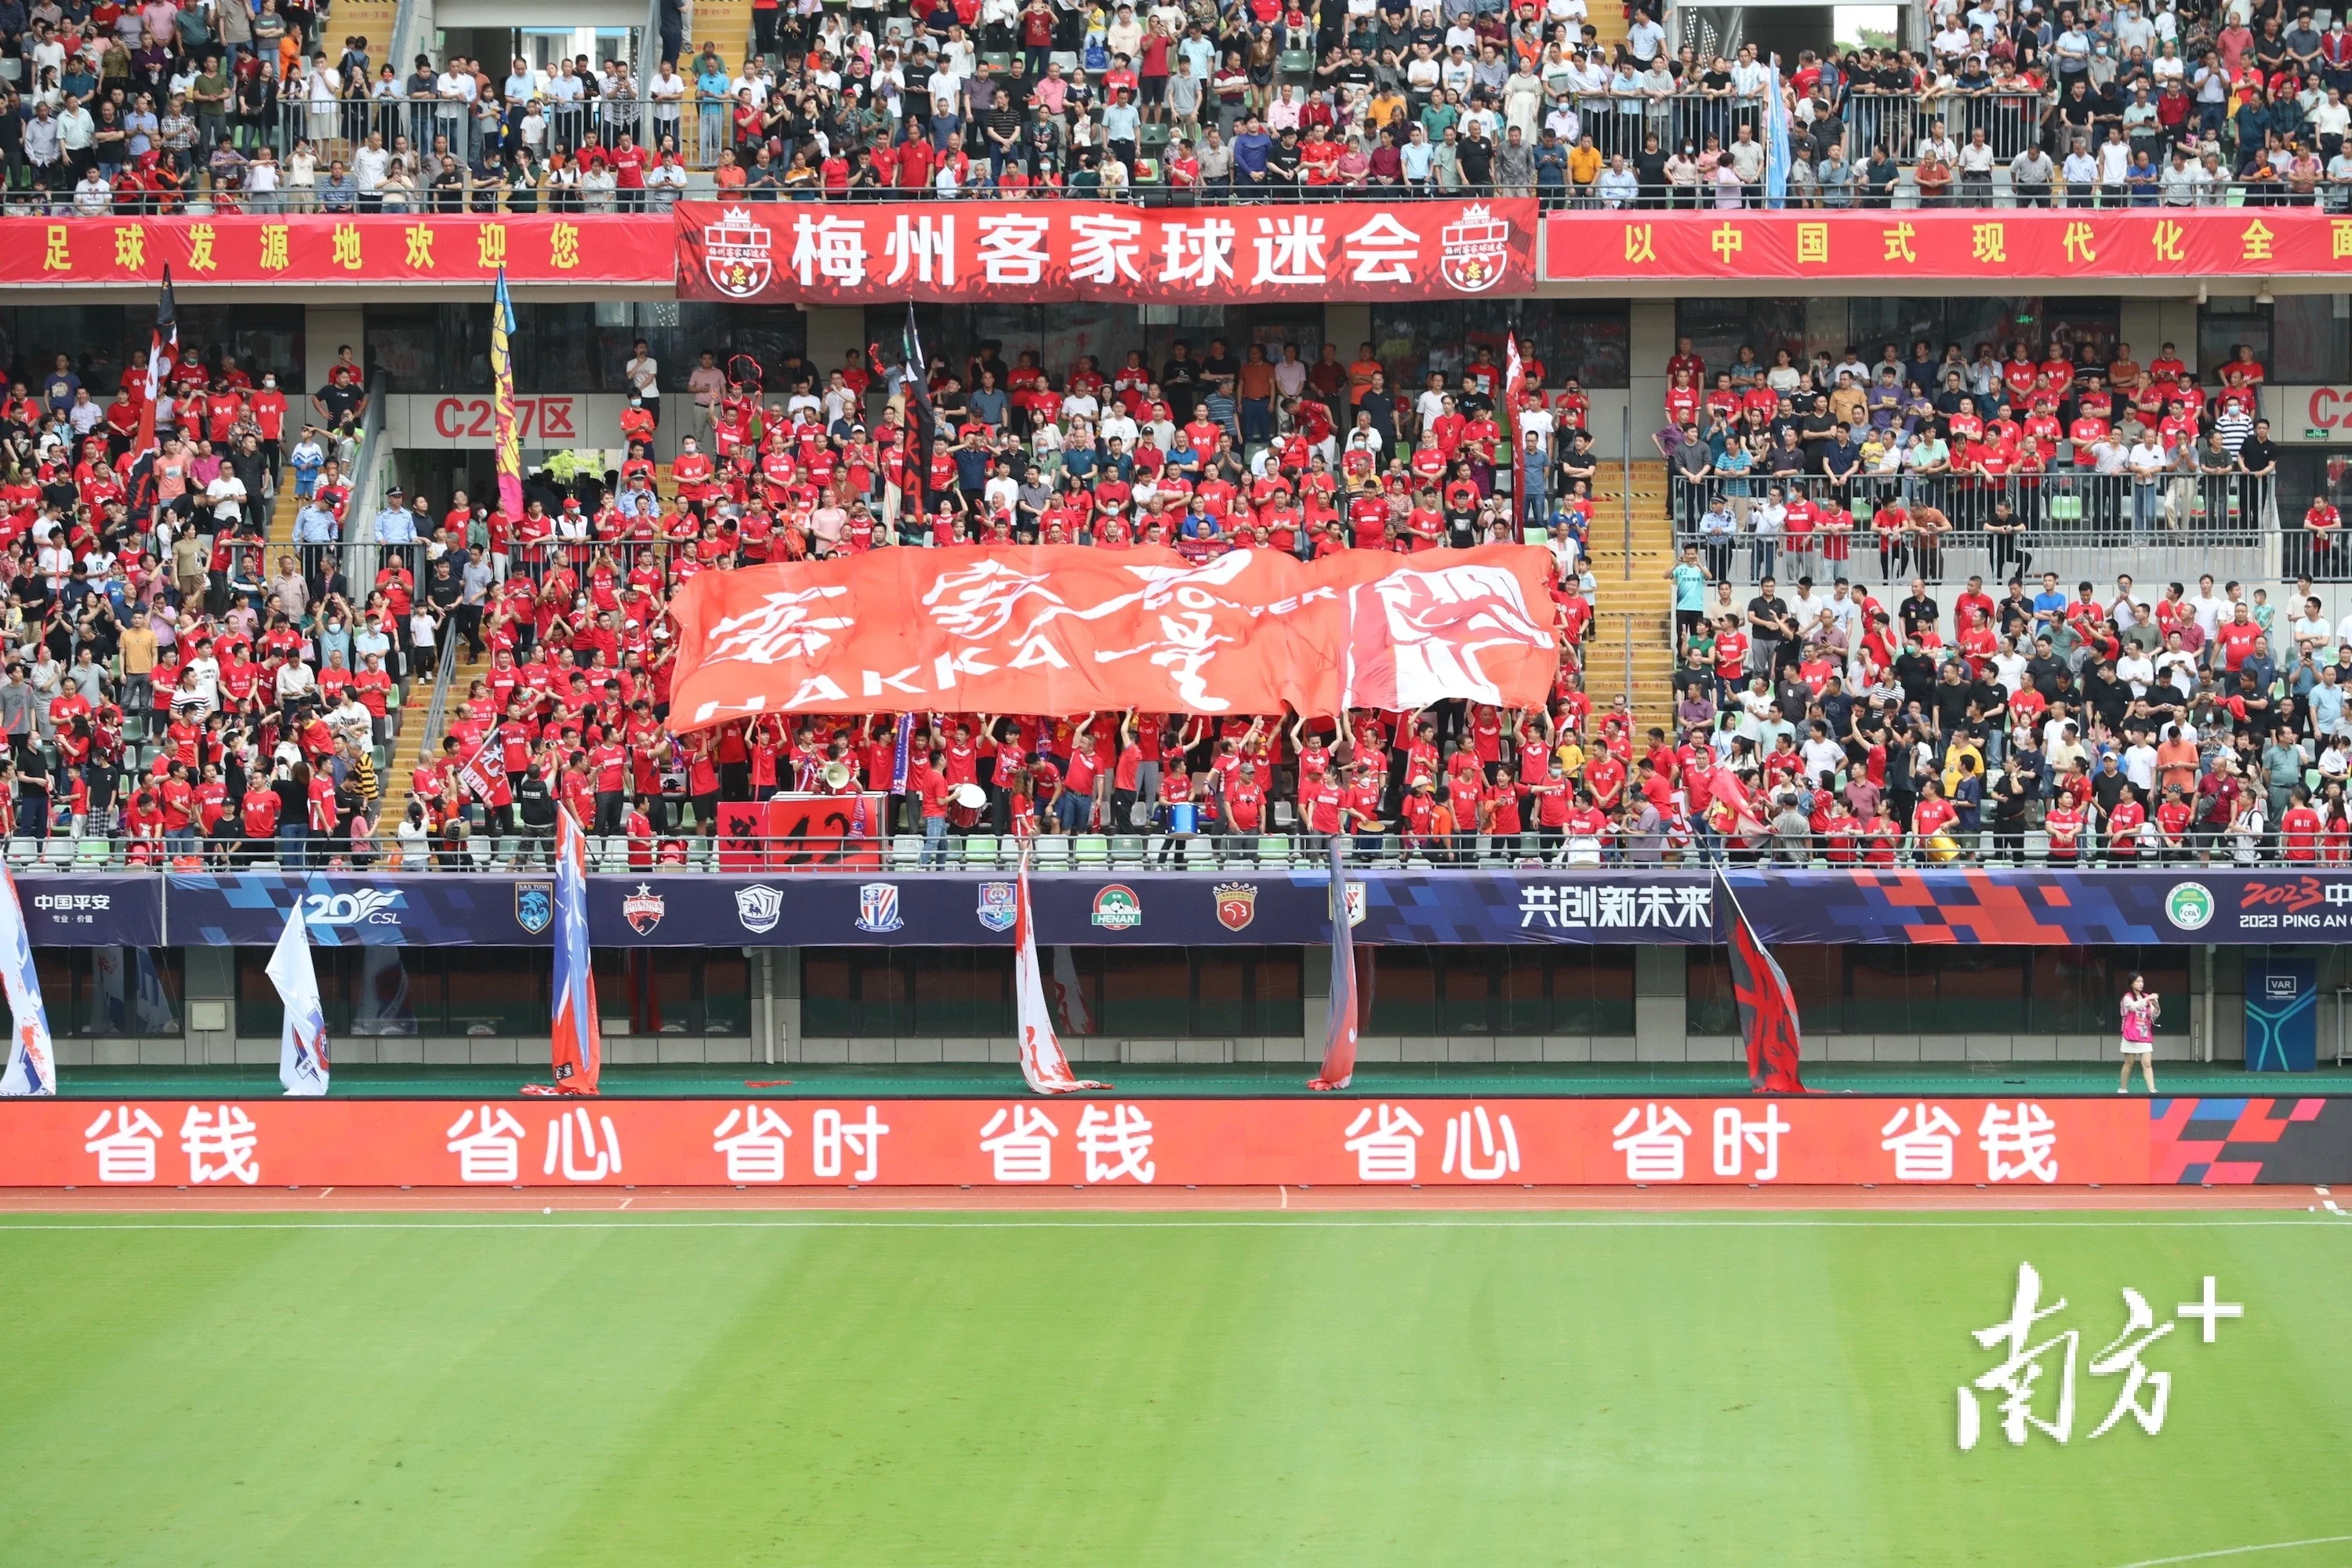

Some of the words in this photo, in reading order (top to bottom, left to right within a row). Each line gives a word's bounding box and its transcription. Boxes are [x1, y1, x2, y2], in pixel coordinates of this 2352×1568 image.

[44, 223, 579, 270] 足球发源地欢迎您
[792, 212, 1421, 287] 梅州客家球迷会
[435, 396, 576, 439] C27区
[96, 561, 103, 572] R
[694, 630, 1072, 724] HAKKA
[34, 894, 111, 910] 中国平安
[306, 892, 361, 924] 20
[626, 900, 662, 909] SHENZHEN
[1519, 884, 1711, 928] 共创新未来
[52, 914, 94, 924] 专业·价值
[368, 913, 402, 925] CSL
[1097, 914, 1136, 924] HENAN
[2239, 914, 2278, 928] 2023
[2282, 914, 2321, 928] PING
[2322, 914, 2347, 928] AN
[2270, 980, 2292, 989] VAR
[85, 1105, 260, 1185] 省钱
[446, 1105, 622, 1182] 省心
[713, 1104, 890, 1181] 省时
[979, 1103, 1156, 1184] 省钱
[1344, 1103, 1520, 1181] 省心
[1613, 1102, 1791, 1181] 省时
[1881, 1102, 2058, 1183] 省钱
